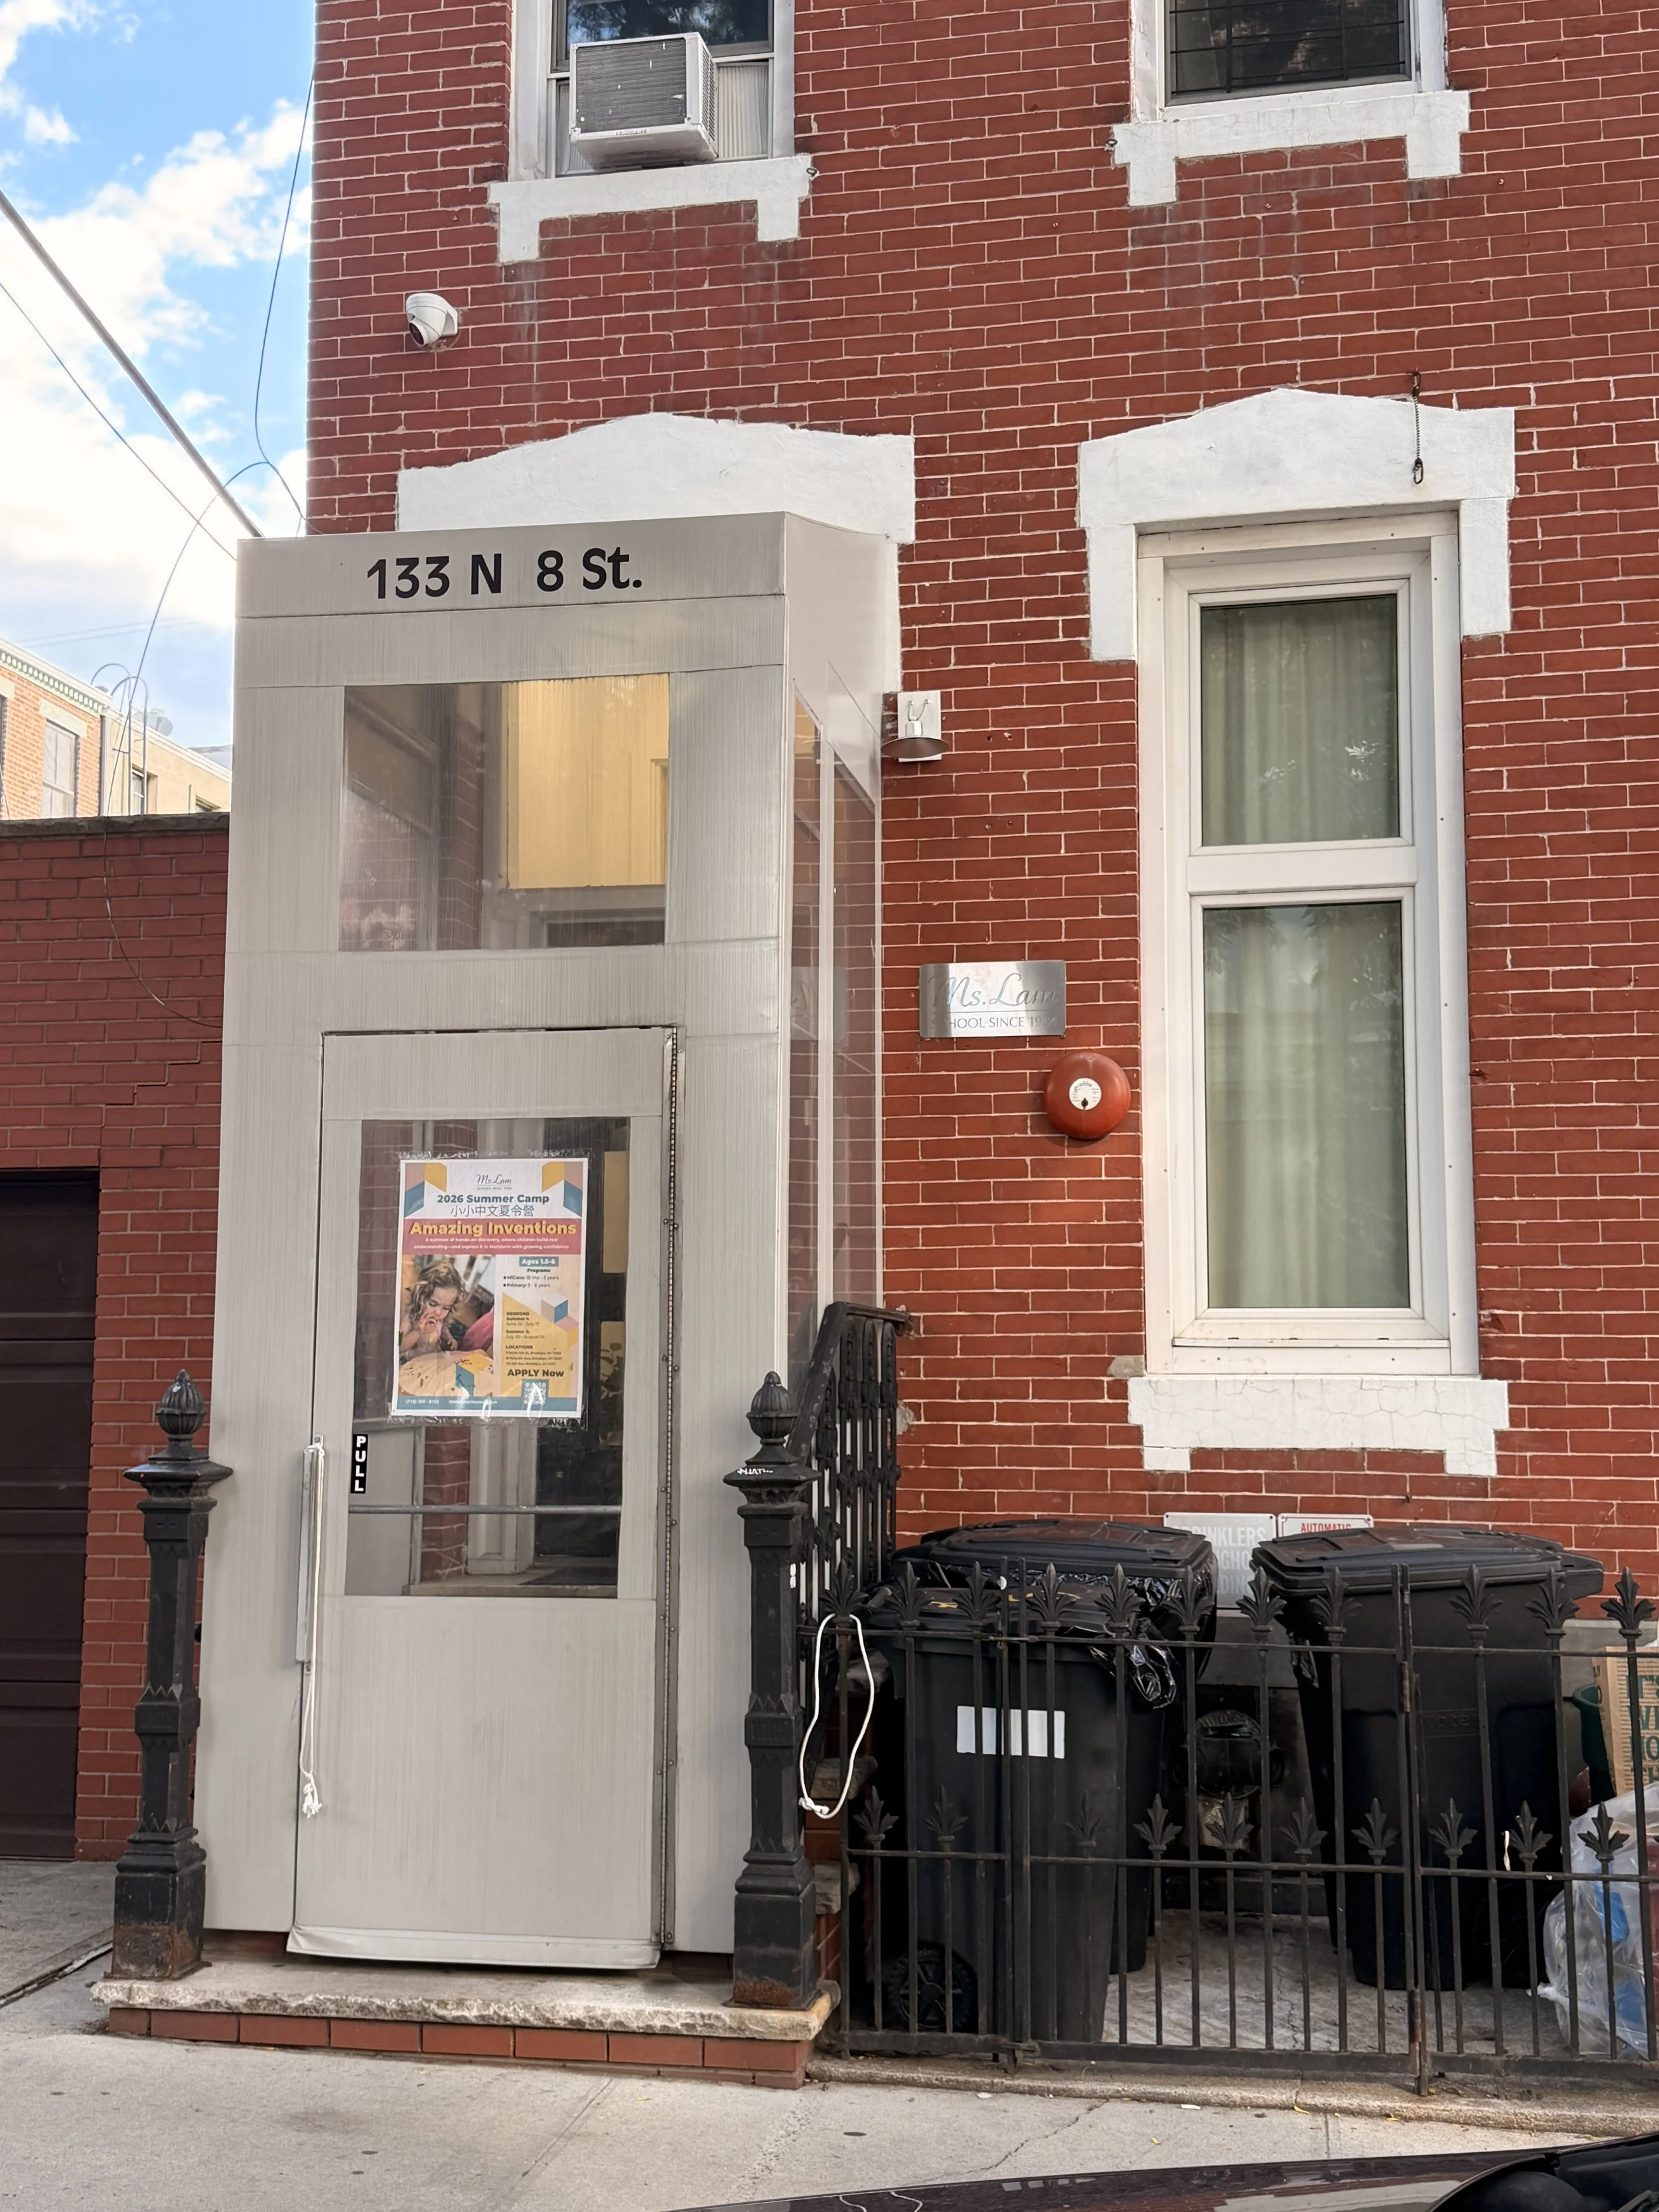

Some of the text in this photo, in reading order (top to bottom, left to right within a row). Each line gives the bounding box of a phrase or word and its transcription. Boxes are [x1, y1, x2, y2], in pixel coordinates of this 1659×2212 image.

[367, 546, 642, 599] 133 N 8 St.
[989, 1017, 1025, 1028] SINCE
[437, 1194, 549, 1205] 2026 Summer Camp
[451, 1205, 535, 1217] 小小中文夏令營
[409, 1220, 577, 1237] Amazing Inventions
[507, 1368, 540, 1377] APPLY
[354, 1436, 366, 1492] PULL
